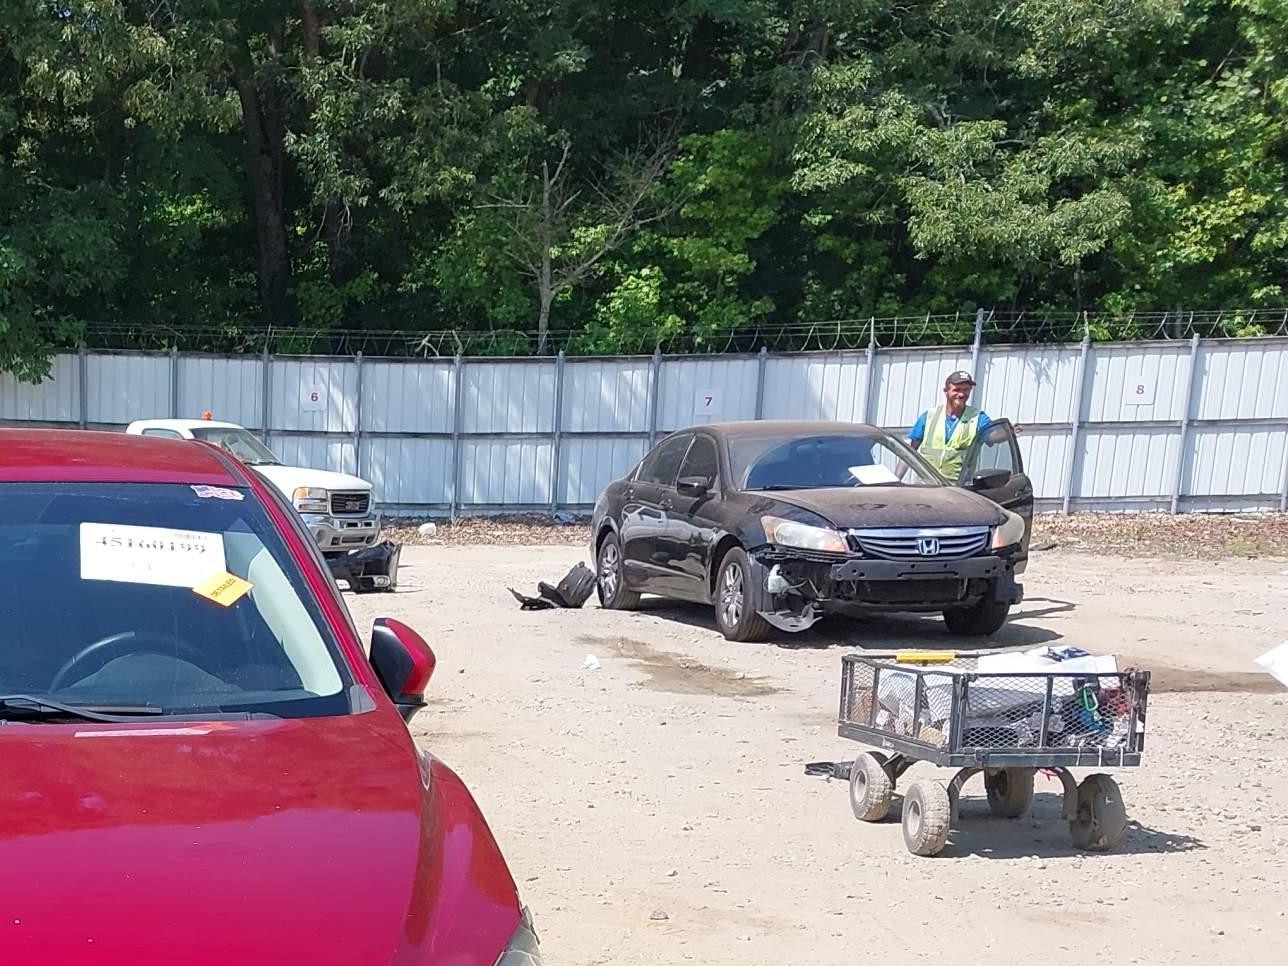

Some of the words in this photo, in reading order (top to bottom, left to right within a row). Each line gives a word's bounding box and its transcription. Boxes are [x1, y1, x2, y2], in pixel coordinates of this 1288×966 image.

[1136, 385, 1144, 394] 8
[311, 393, 318, 402] 6
[705, 397, 712, 406] 7
[96, 536, 207, 554] 45160199
